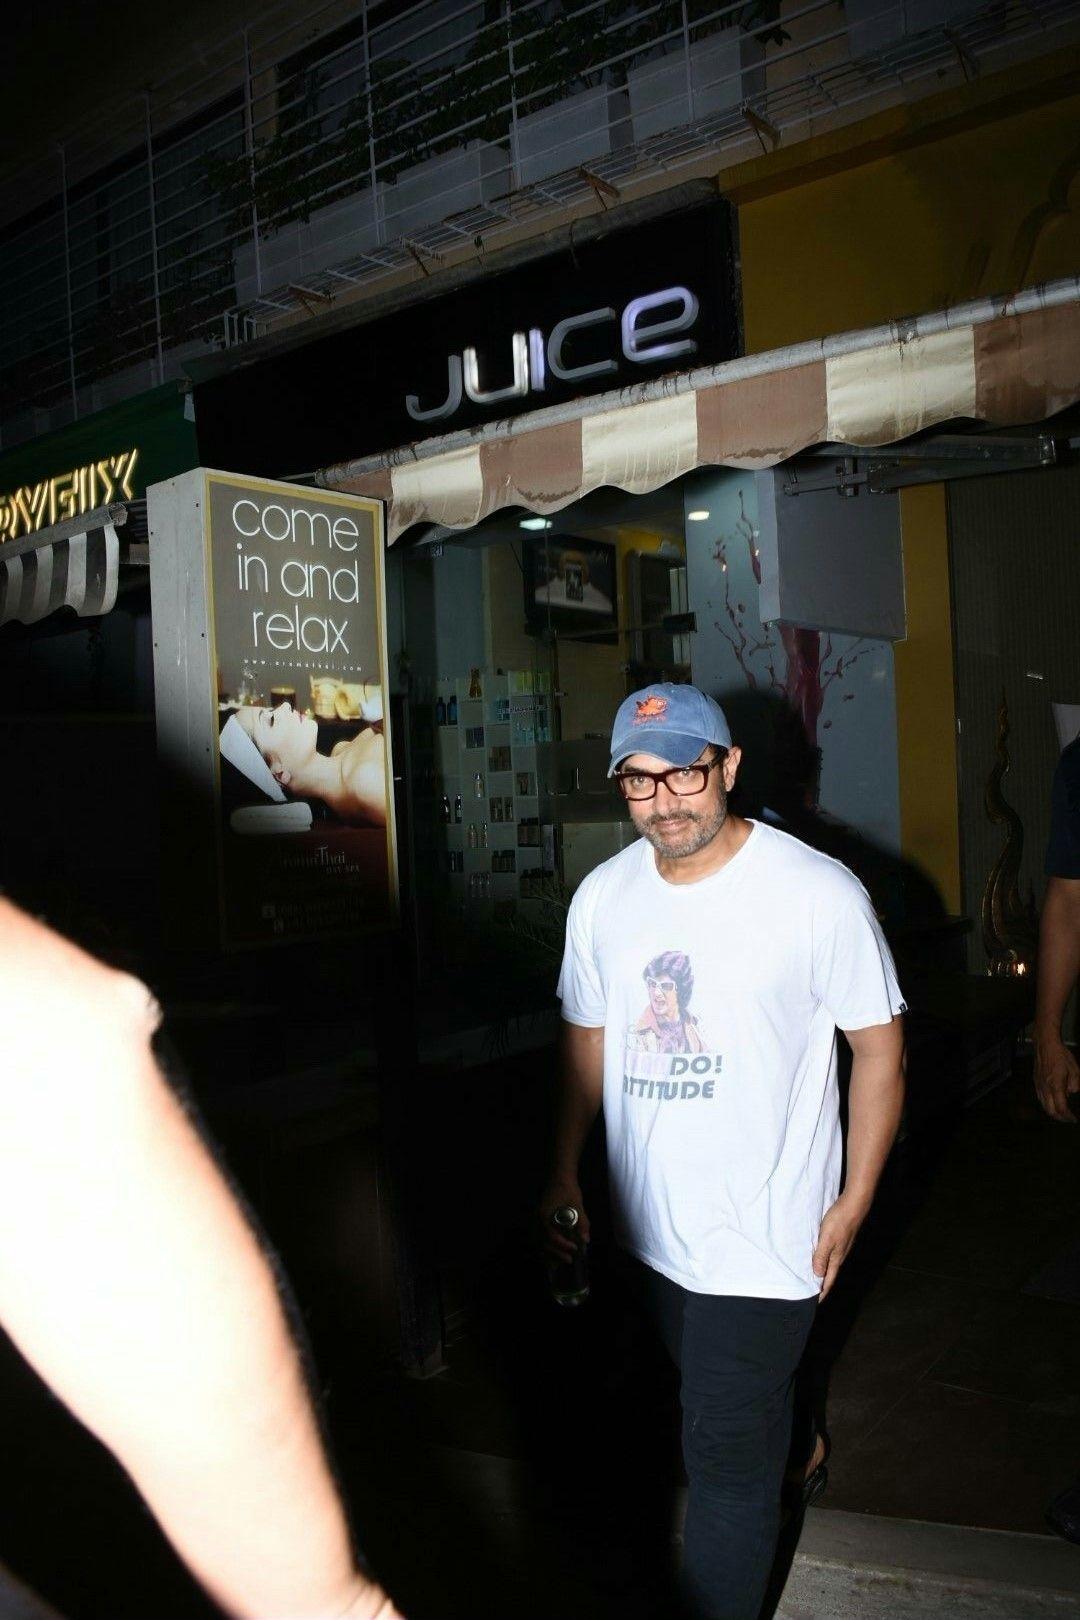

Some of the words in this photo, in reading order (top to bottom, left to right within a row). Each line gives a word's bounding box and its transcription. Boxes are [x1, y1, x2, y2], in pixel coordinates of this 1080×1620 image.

[232, 499, 360, 551] come
[236, 541, 269, 593] in
[280, 560, 360, 604] and
[252, 604, 350, 655] relax
[669, 1055, 723, 1076] DO!
